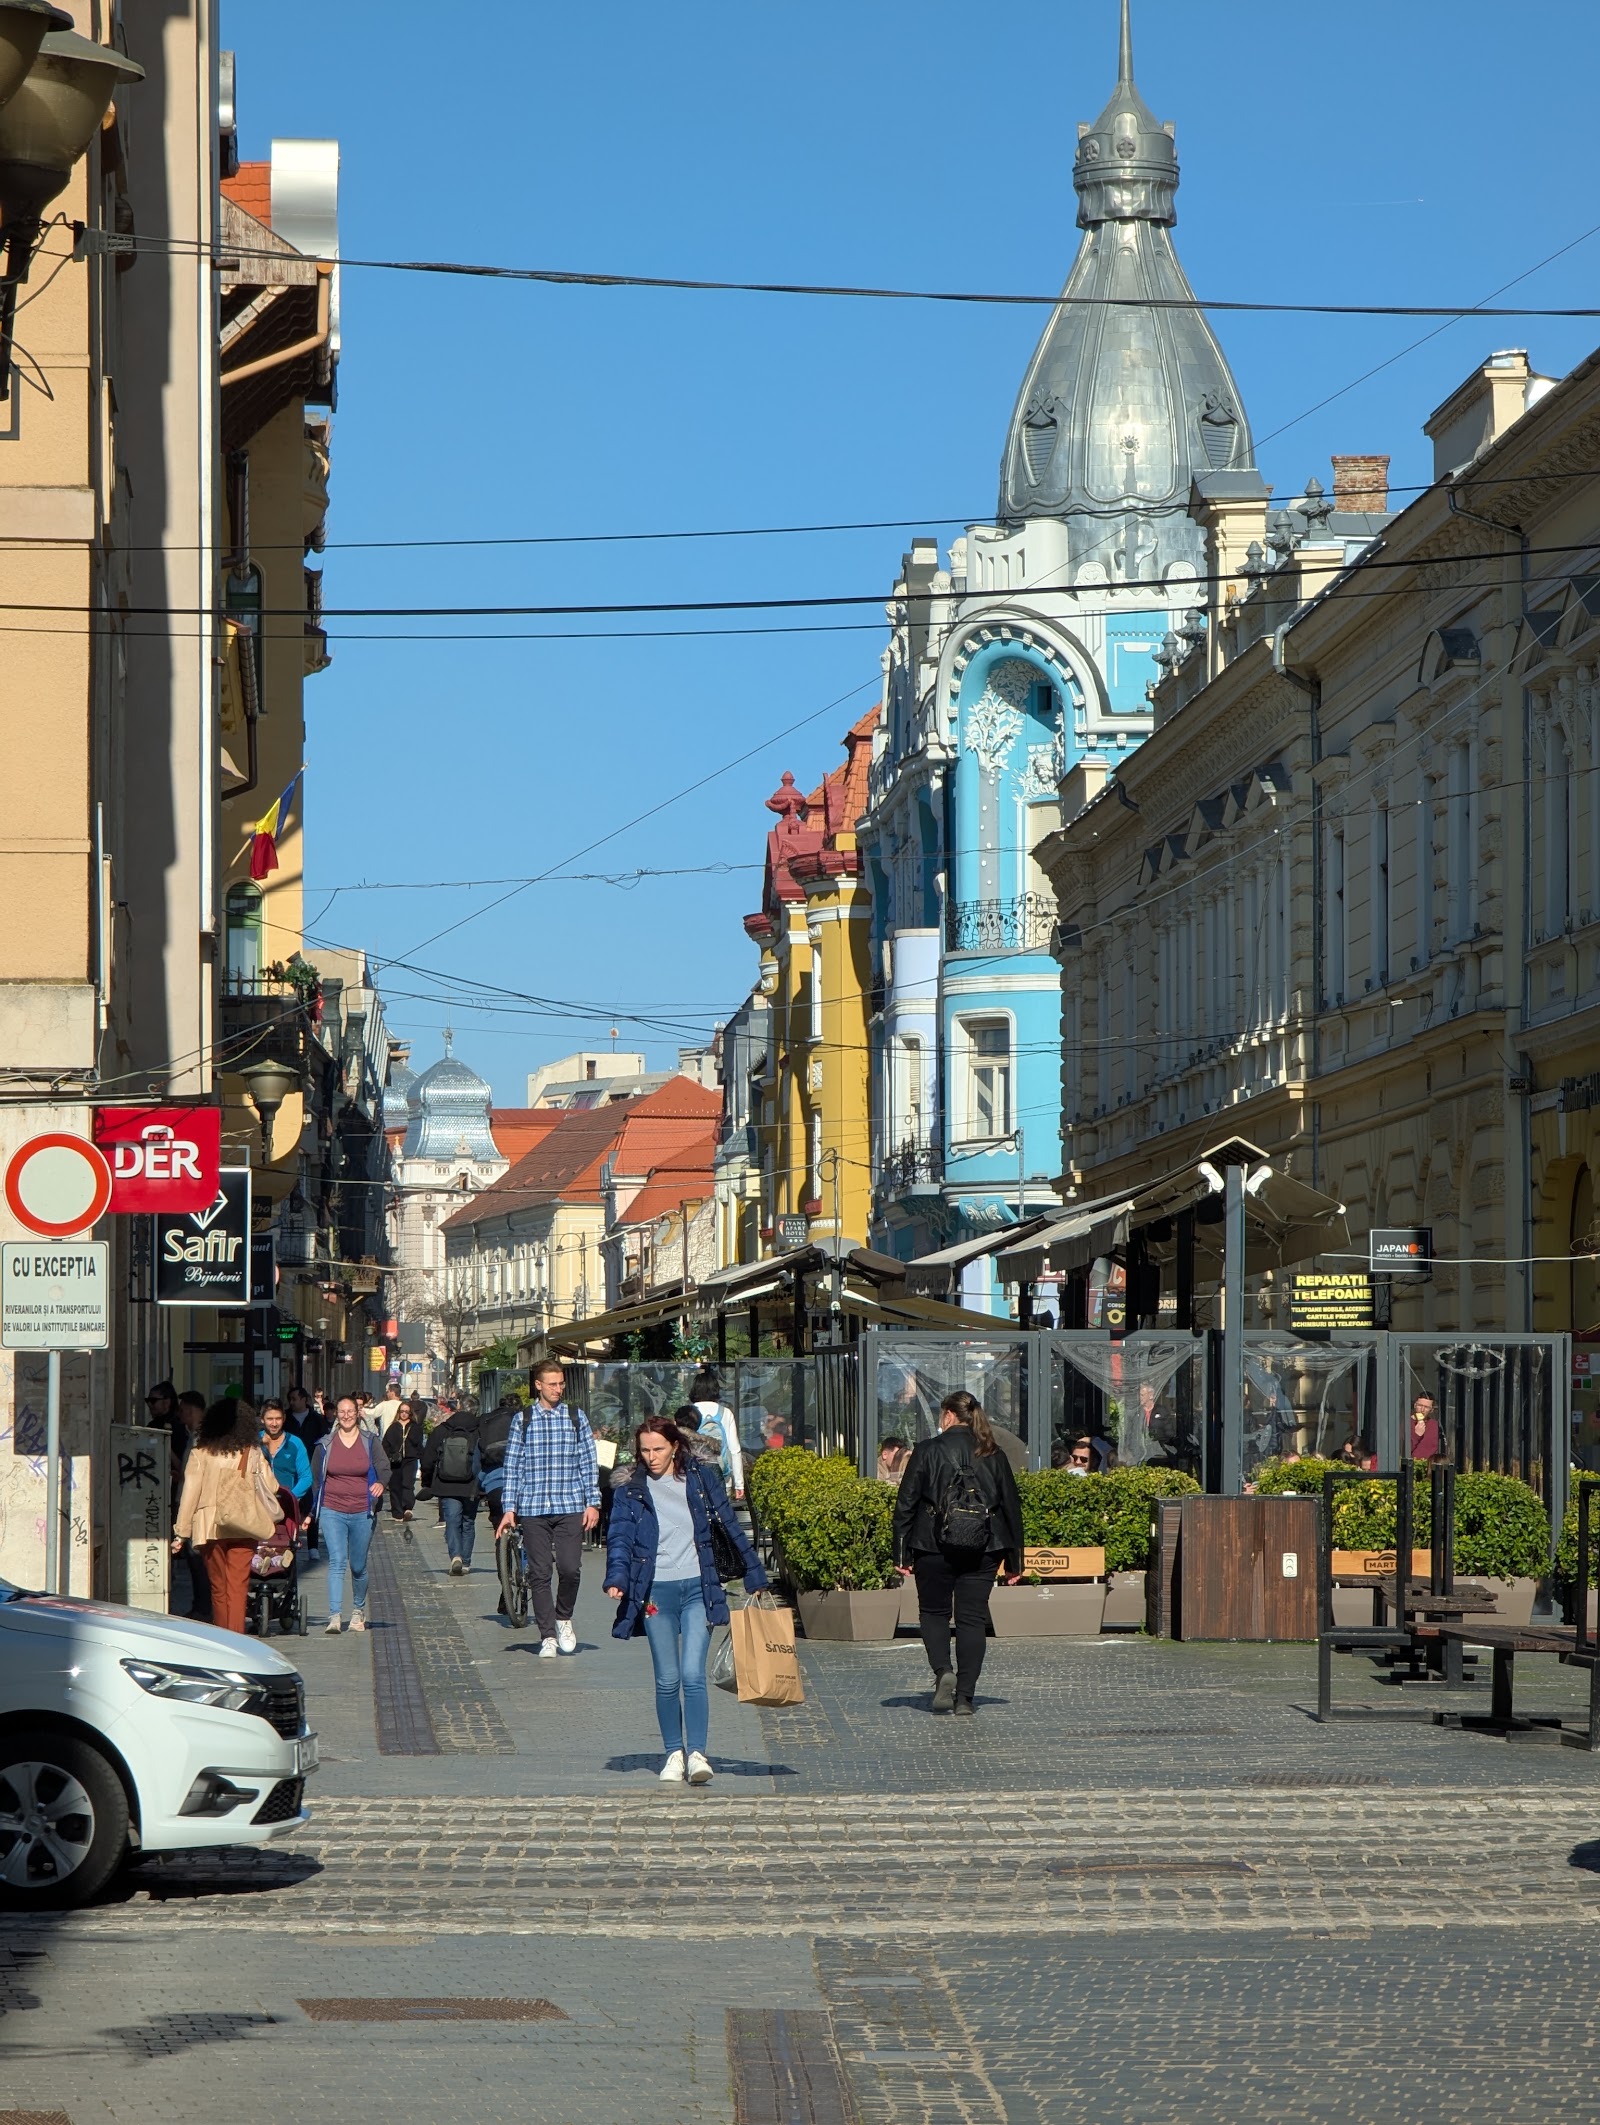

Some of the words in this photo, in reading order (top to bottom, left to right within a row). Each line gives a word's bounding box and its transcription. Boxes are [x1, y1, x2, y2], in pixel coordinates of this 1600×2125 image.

[164, 1229, 242, 1262] Safir
[13, 1257, 30, 1277] CU
[34, 1256, 97, 1279] EXCEPȚIA
[184, 1266, 242, 1287] Bijuterii
[1292, 1288, 1373, 1300] TELEFOANE
[5, 1305, 42, 1315] RIVERANILOR
[50, 1305, 55, 1315] A
[55, 1305, 102, 1315] TRANSPORTULUI
[3, 1322, 11, 1332] DE
[12, 1322, 33, 1332] VALORI
[33, 1322, 41, 1332] LA
[79, 1322, 105, 1332] BANCARE
